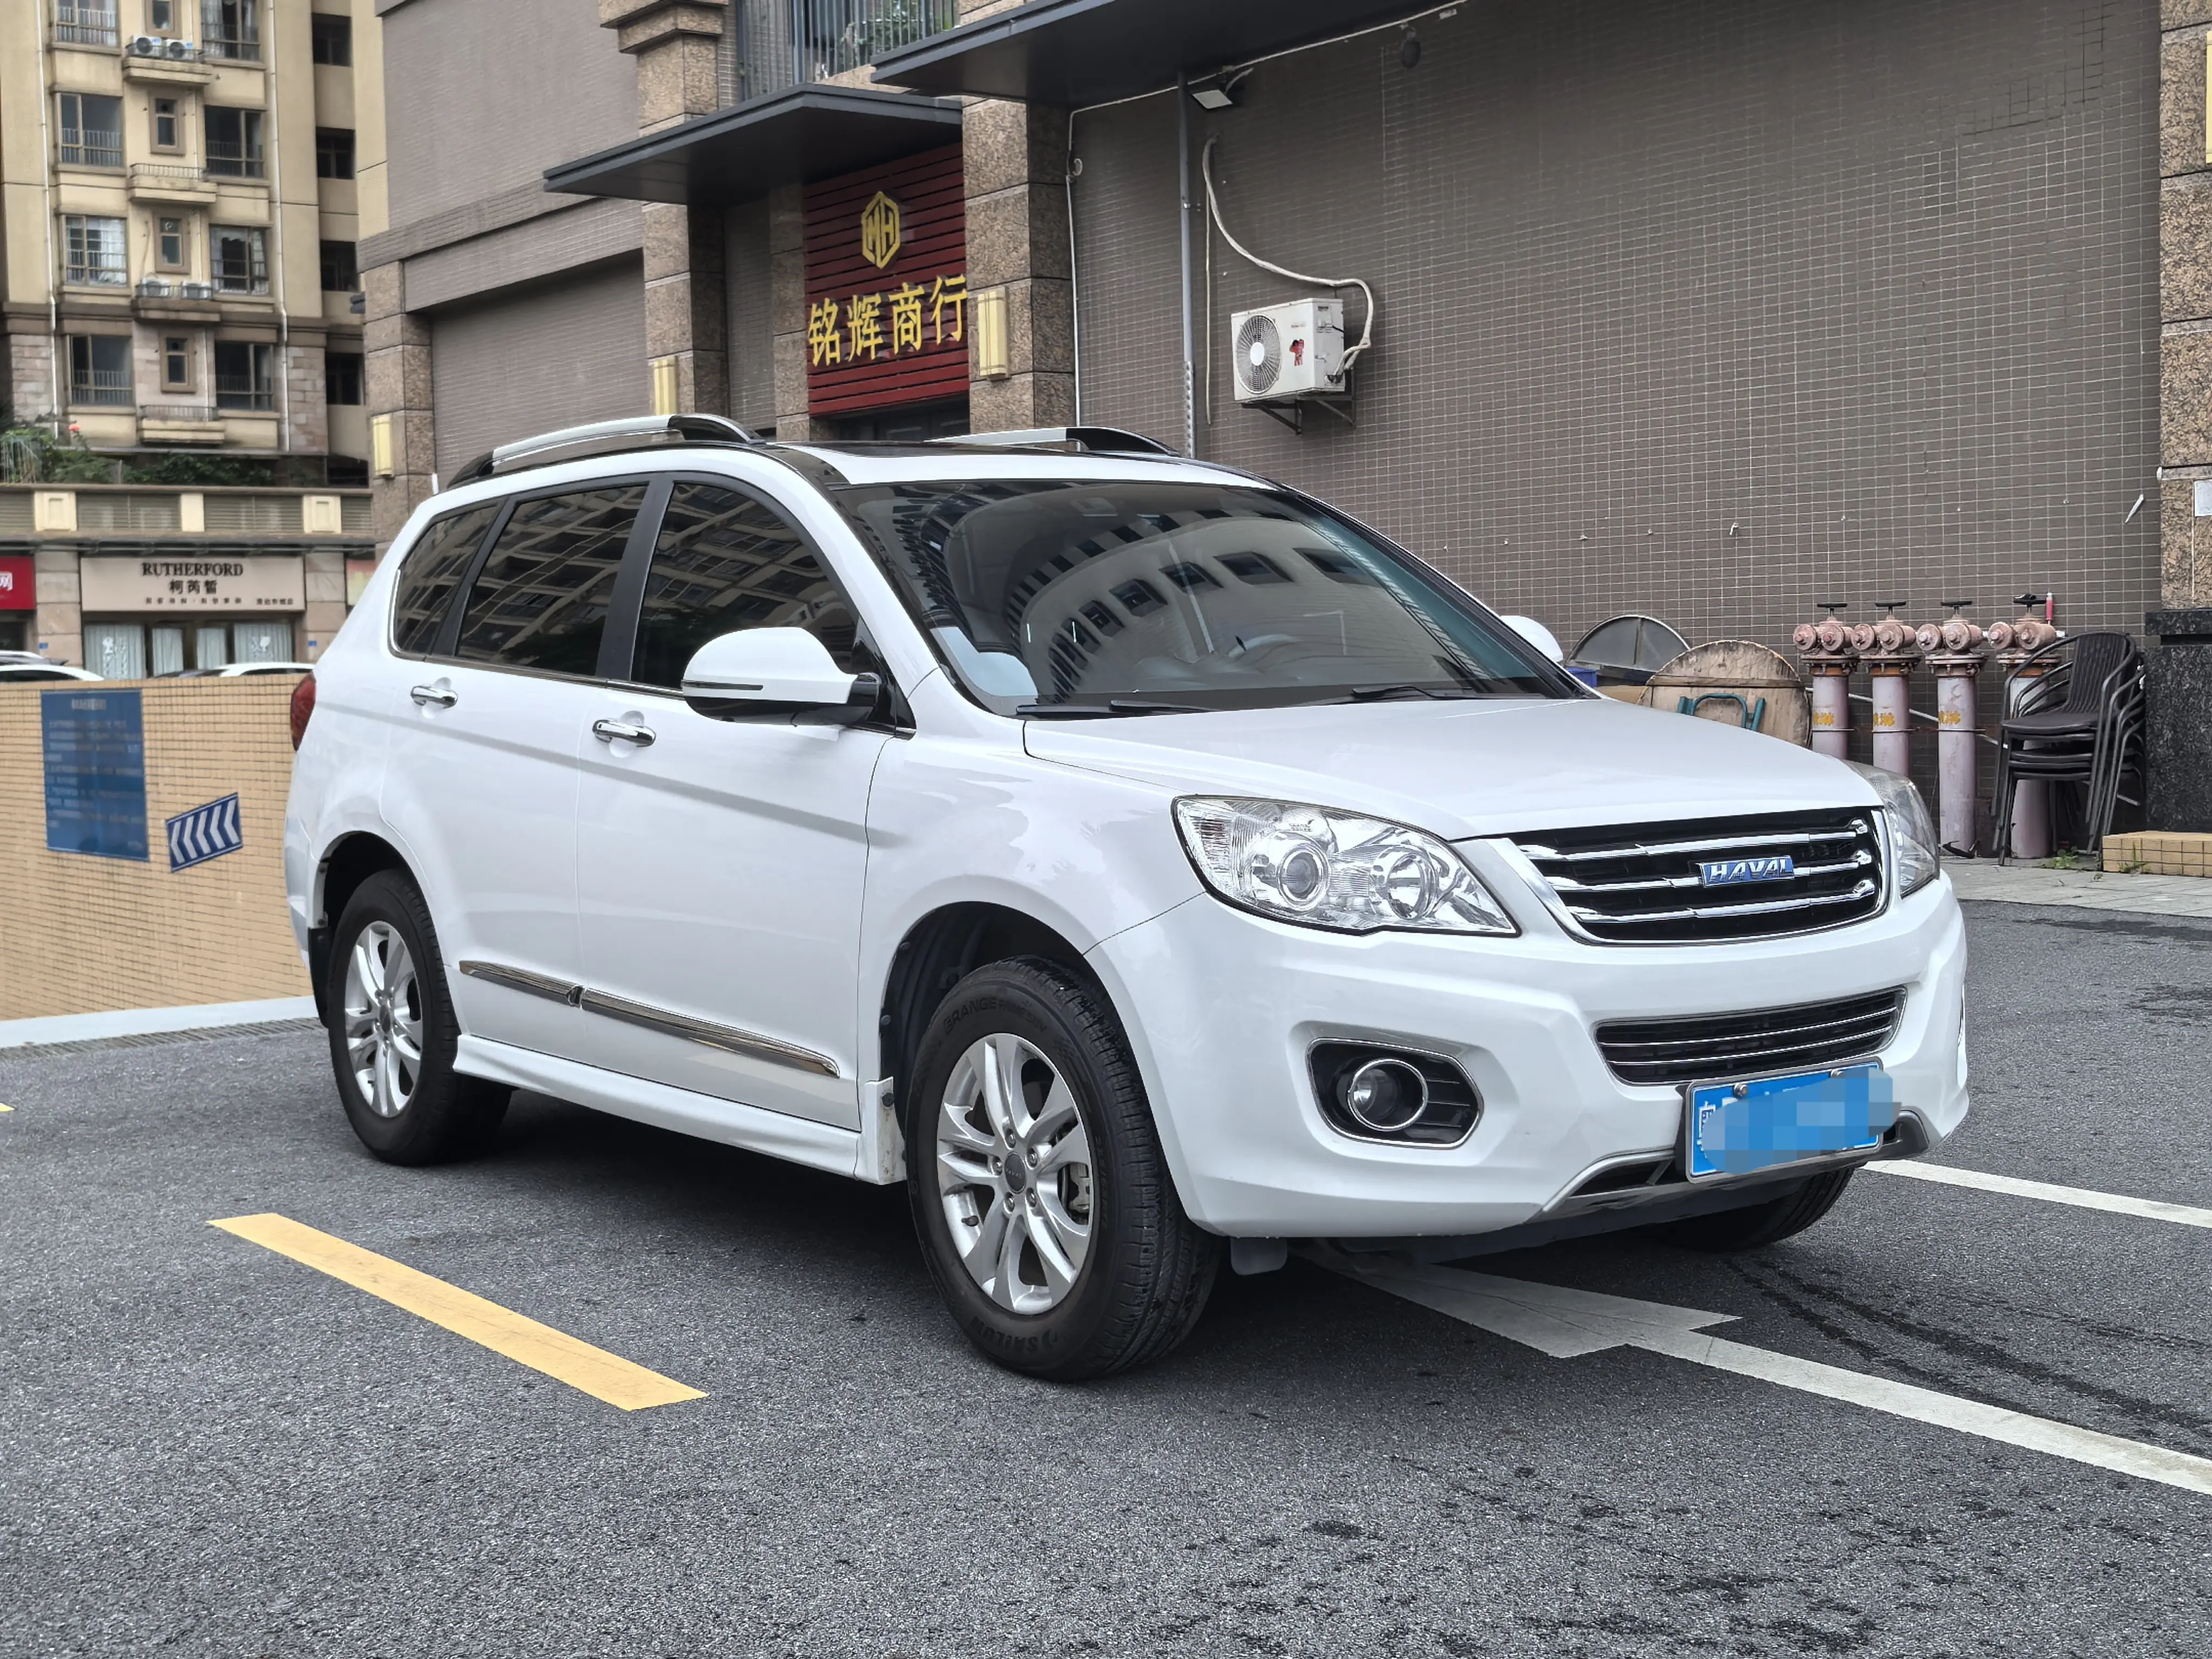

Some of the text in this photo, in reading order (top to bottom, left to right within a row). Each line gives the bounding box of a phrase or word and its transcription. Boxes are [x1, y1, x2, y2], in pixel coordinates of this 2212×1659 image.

[808, 274, 968, 367] 铭辉商行
[141, 562, 244, 576] RUTHERFORD
[1709, 859, 1792, 883] HAVAL
